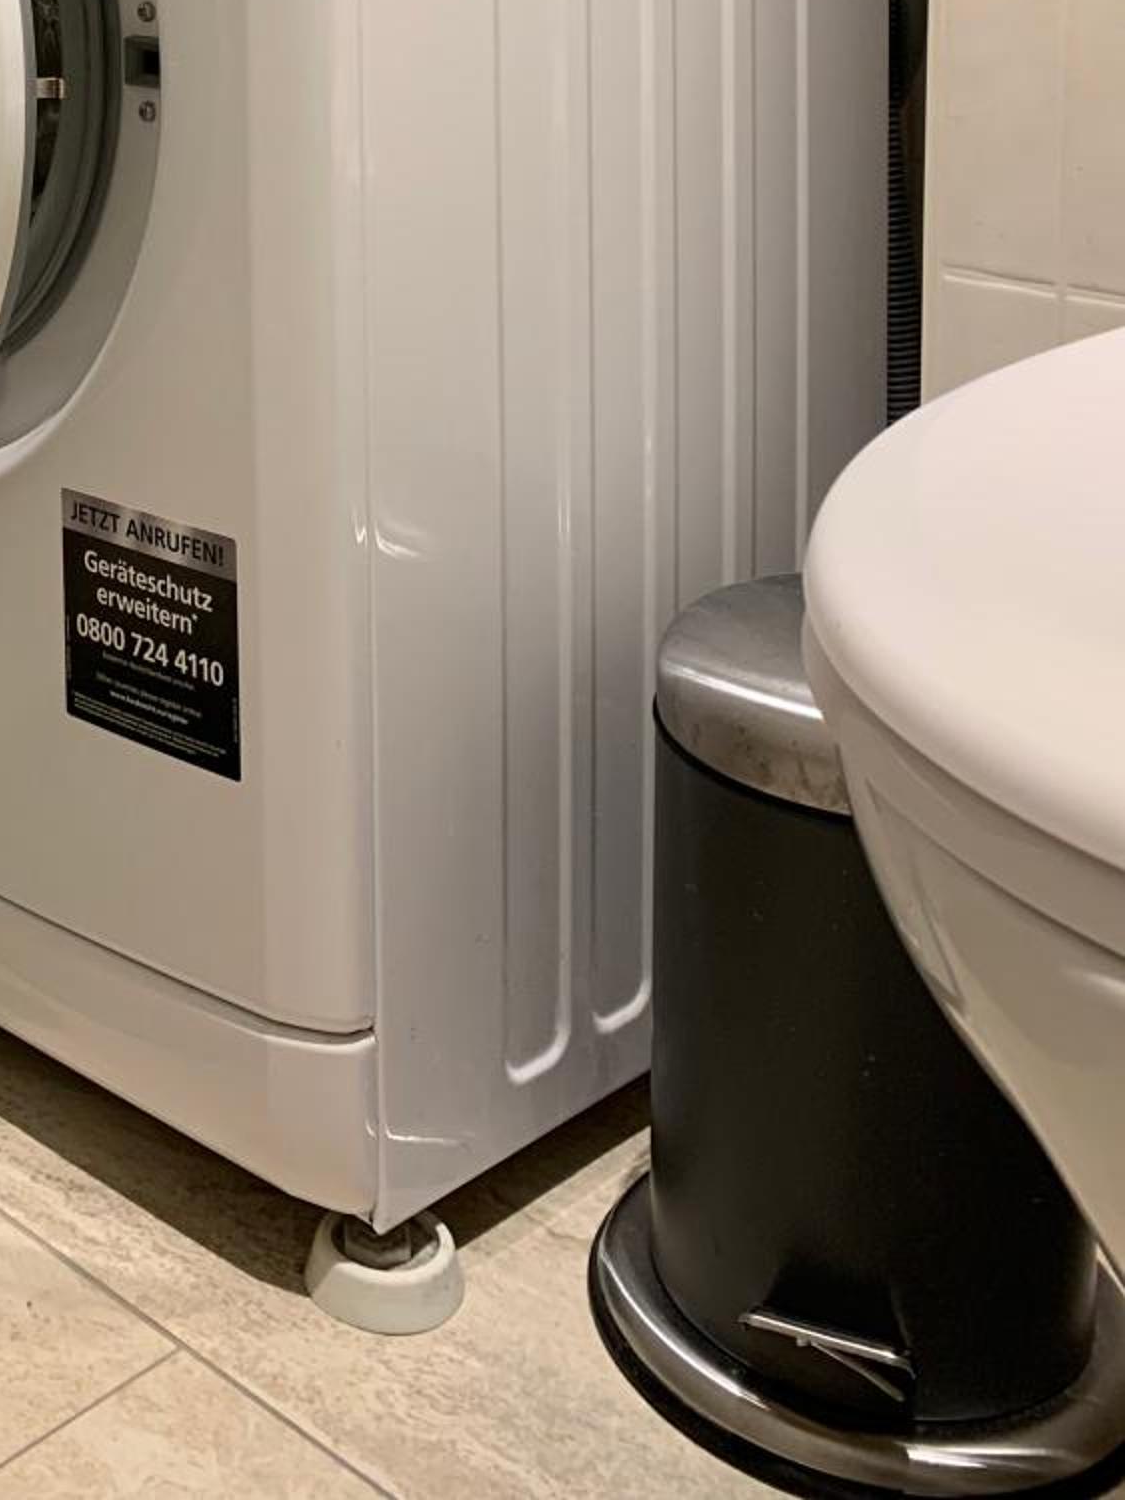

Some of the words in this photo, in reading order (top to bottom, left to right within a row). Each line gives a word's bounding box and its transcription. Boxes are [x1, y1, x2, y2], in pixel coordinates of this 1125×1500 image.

[71, 501, 121, 533] JETZT
[125, 518, 224, 567] ANRUFEN!
[83, 550, 214, 613] Geräteschutz
[76, 612, 125, 651] 0800
[130, 631, 169, 667] 724
[174, 649, 224, 687] 4110
